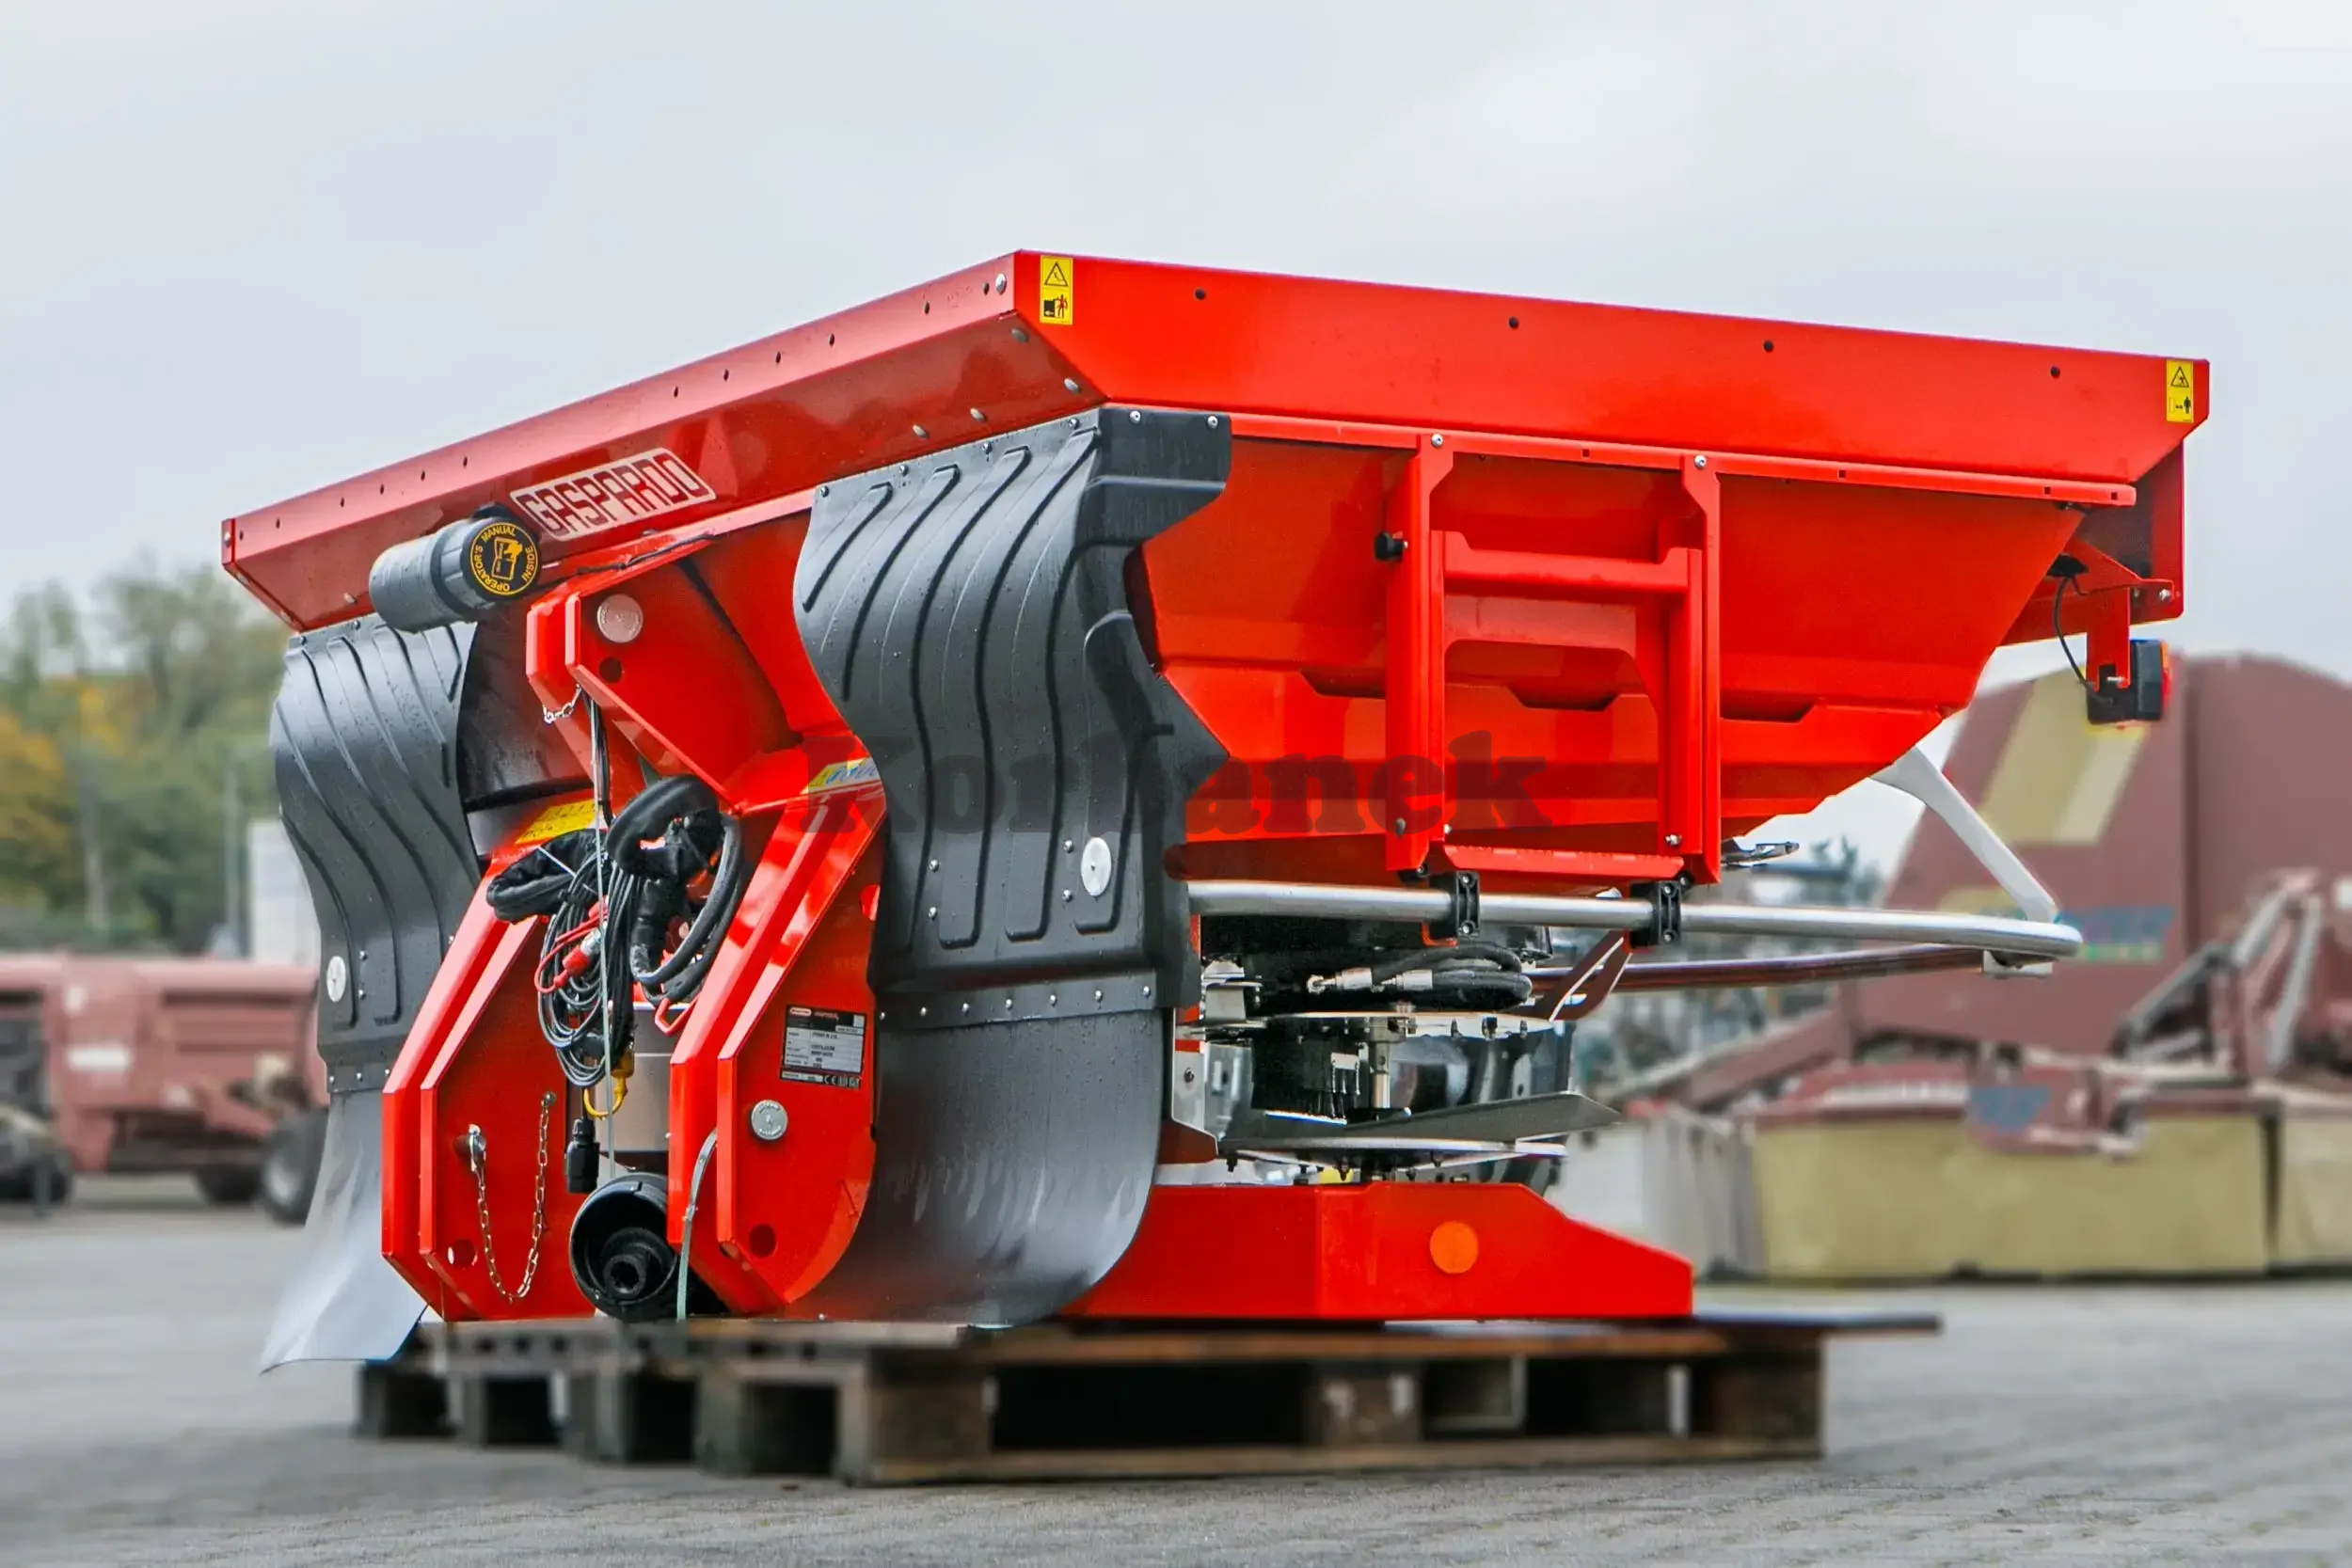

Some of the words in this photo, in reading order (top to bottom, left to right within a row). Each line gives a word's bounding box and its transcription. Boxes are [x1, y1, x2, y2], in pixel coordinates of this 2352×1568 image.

[515, 452, 712, 538] GASPARDO
[481, 525, 516, 543] MANUAL
[473, 545, 511, 592] OPERATOR'S
[520, 546, 535, 582] INSIDE
